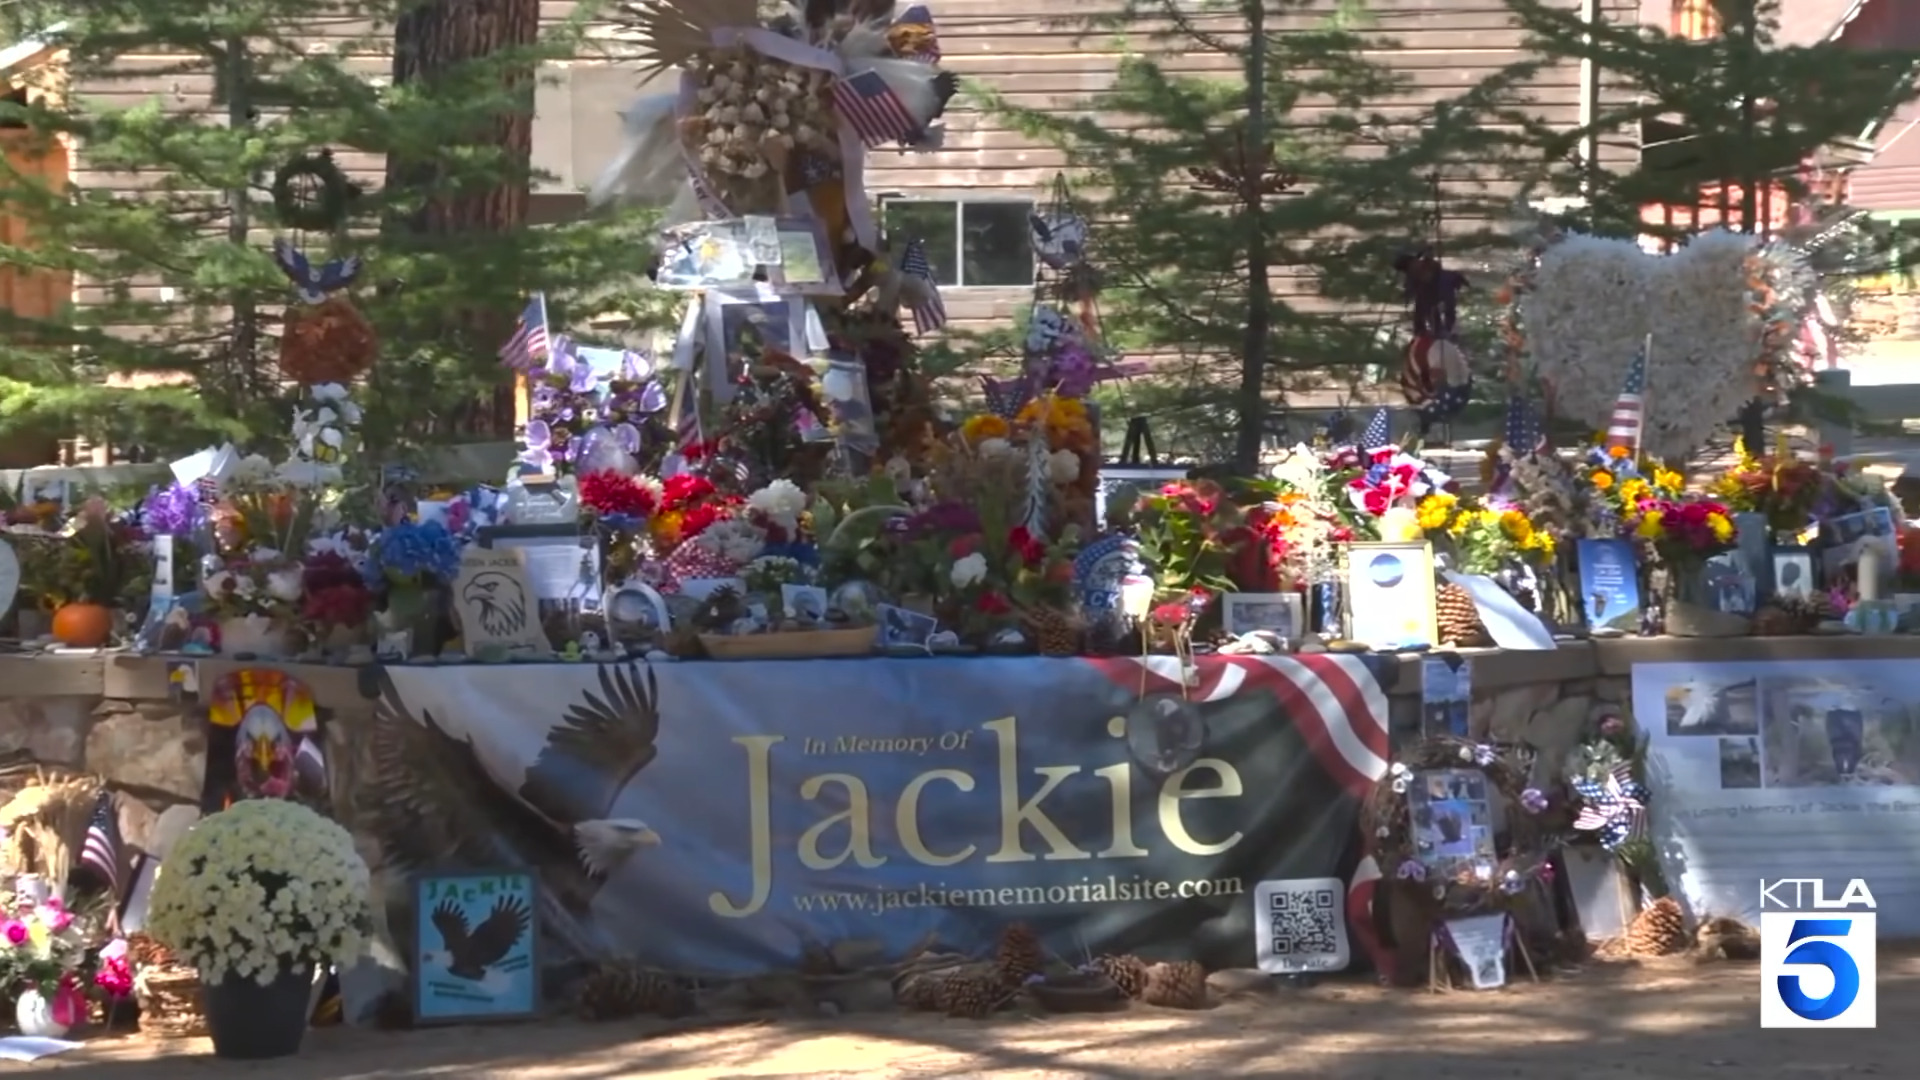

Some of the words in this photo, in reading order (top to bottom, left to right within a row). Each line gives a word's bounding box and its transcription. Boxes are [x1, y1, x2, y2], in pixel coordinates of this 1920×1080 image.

[803, 736, 827, 755] In
[834, 734, 935, 756] Memory
[939, 730, 974, 751] Of
[708, 715, 1244, 918] Jackie
[426, 875, 523, 903] JACKIE
[793, 874, 1244, 916] www.jackiememorialsite.com
